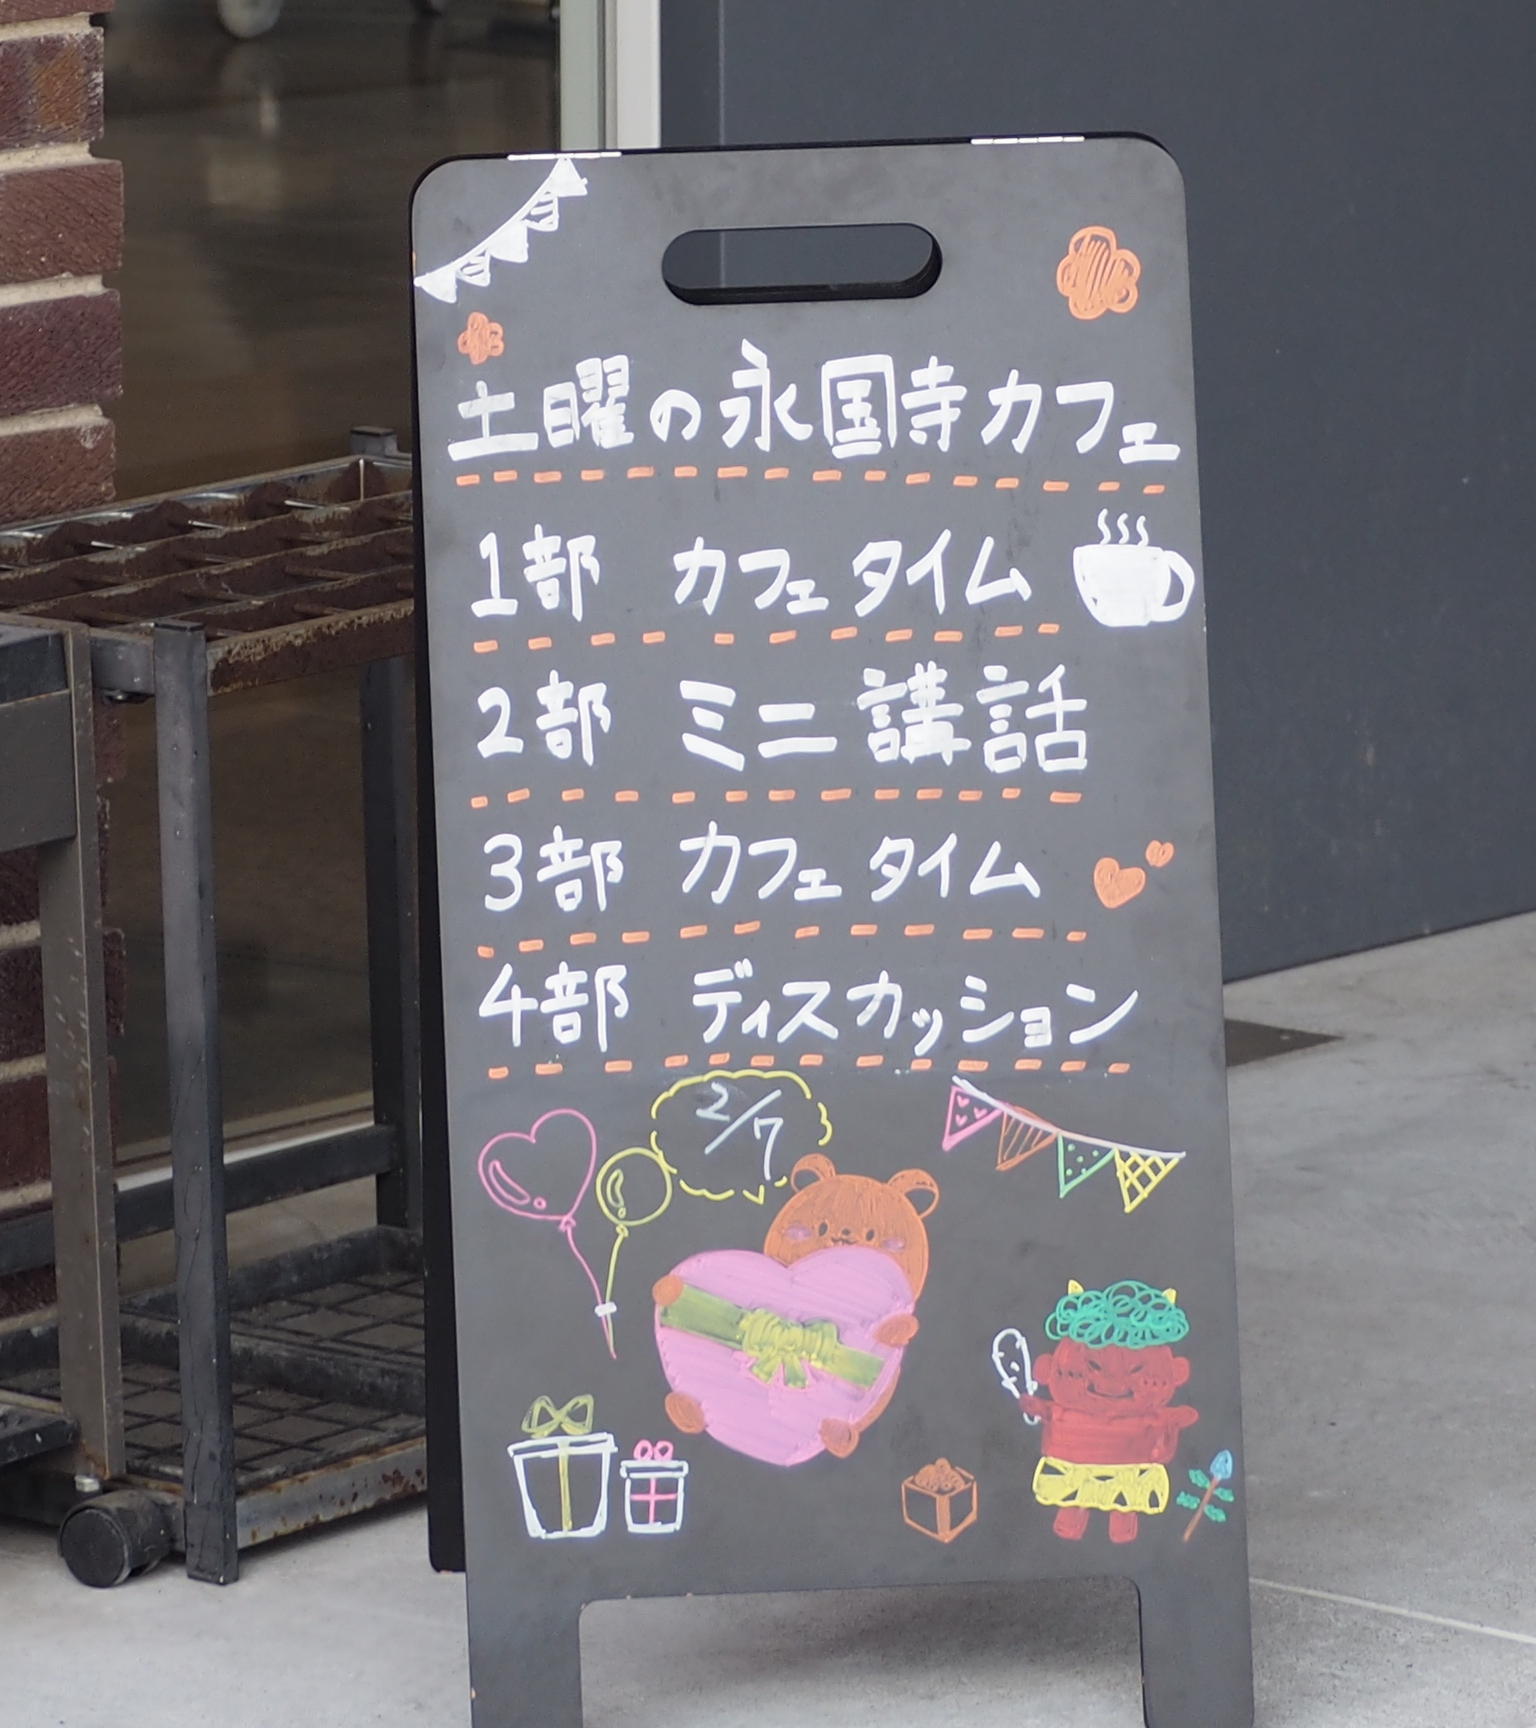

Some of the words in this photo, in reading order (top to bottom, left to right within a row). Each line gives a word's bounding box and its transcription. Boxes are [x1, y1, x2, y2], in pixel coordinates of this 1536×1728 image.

[447, 339, 1181, 464] 土曜の永国寺カフェ
[471, 523, 602, 623] 1部
[476, 670, 613, 767] 2部
[482, 824, 624, 913] 3部
[478, 961, 630, 1052] 4部
[690, 957, 1140, 1056] ディスカッション
[694, 1082, 784, 1181] 2/7
